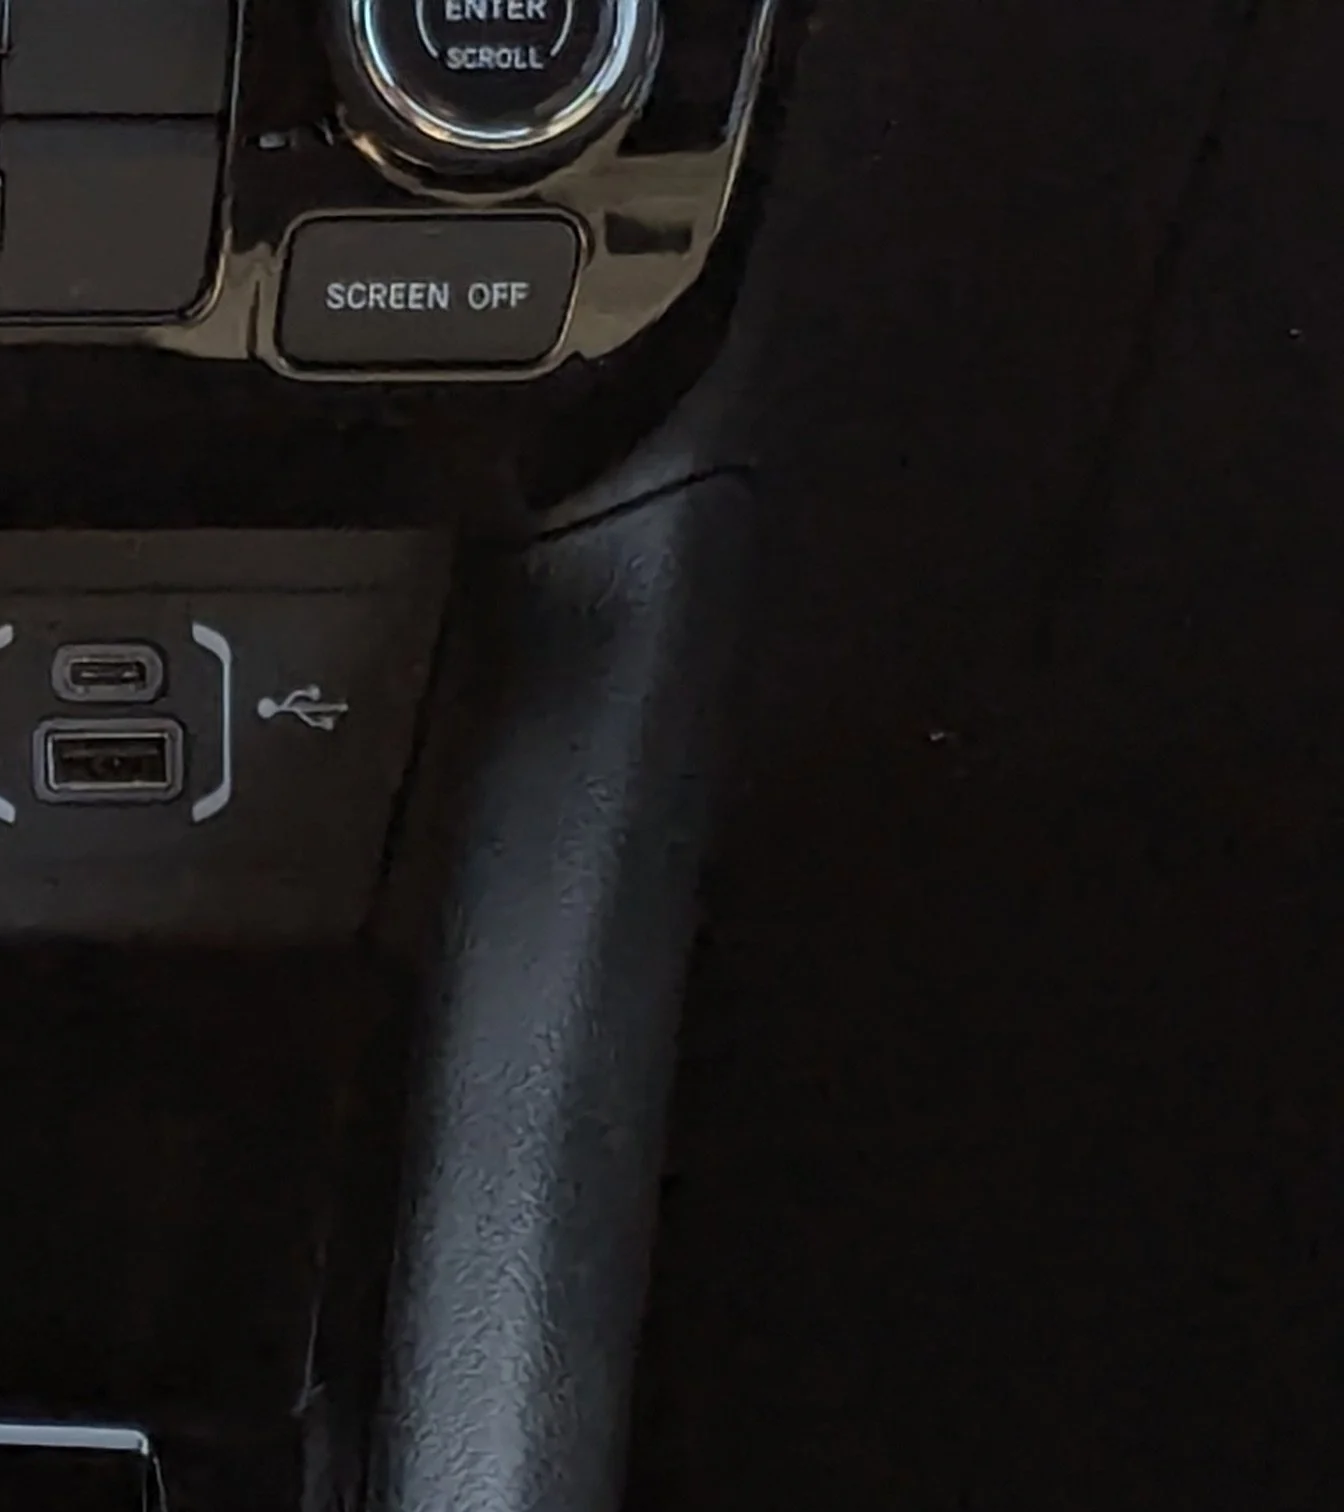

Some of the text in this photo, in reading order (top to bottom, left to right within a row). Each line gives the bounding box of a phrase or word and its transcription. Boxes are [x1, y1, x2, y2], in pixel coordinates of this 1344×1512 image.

[444, 0, 547, 21] ENTER
[446, 47, 544, 70] SCROLL
[326, 282, 529, 310] SCREEN OFF
